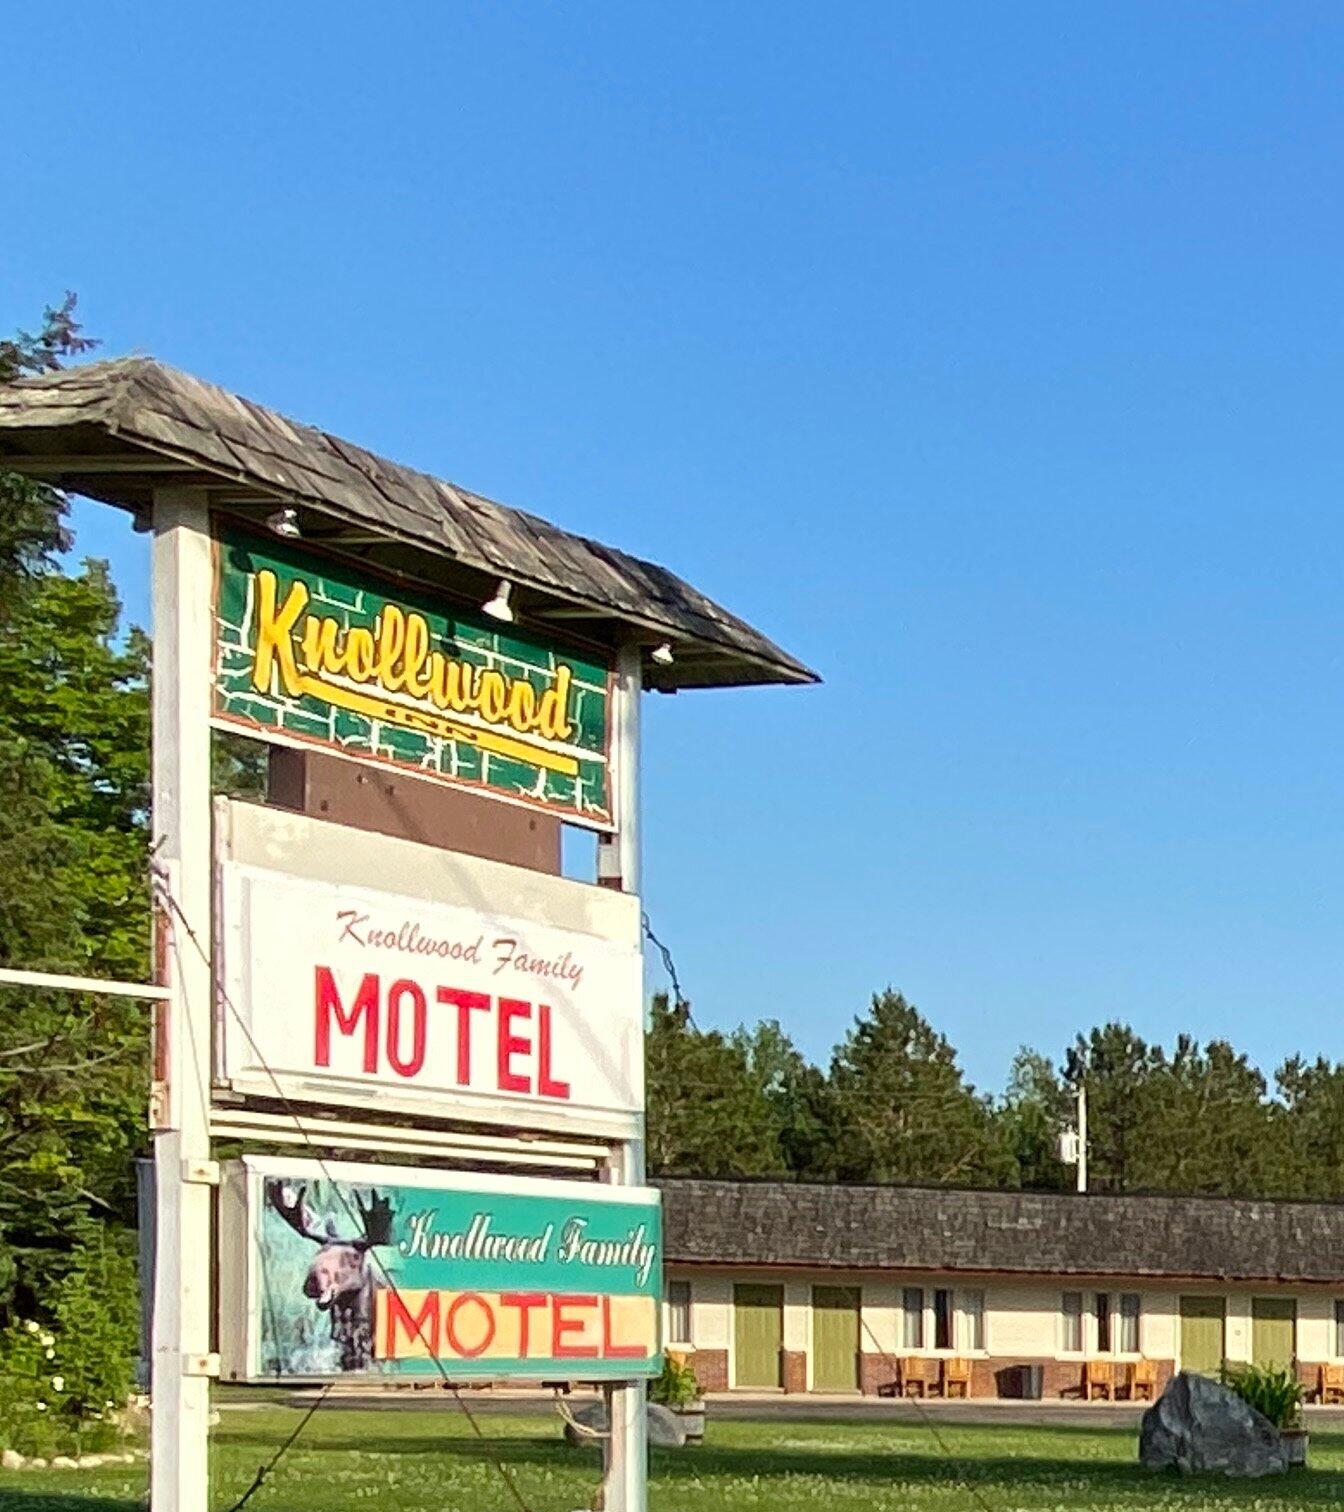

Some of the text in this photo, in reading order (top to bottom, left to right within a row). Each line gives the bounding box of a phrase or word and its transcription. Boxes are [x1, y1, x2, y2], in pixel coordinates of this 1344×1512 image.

[251, 568, 573, 740] Knollwood
[384, 708, 478, 741] INN
[337, 910, 585, 990] Knollwood Family
[313, 965, 571, 1099] MOTEL
[399, 1208, 656, 1286] Knollwood Family
[385, 1290, 648, 1361] MOTEL
